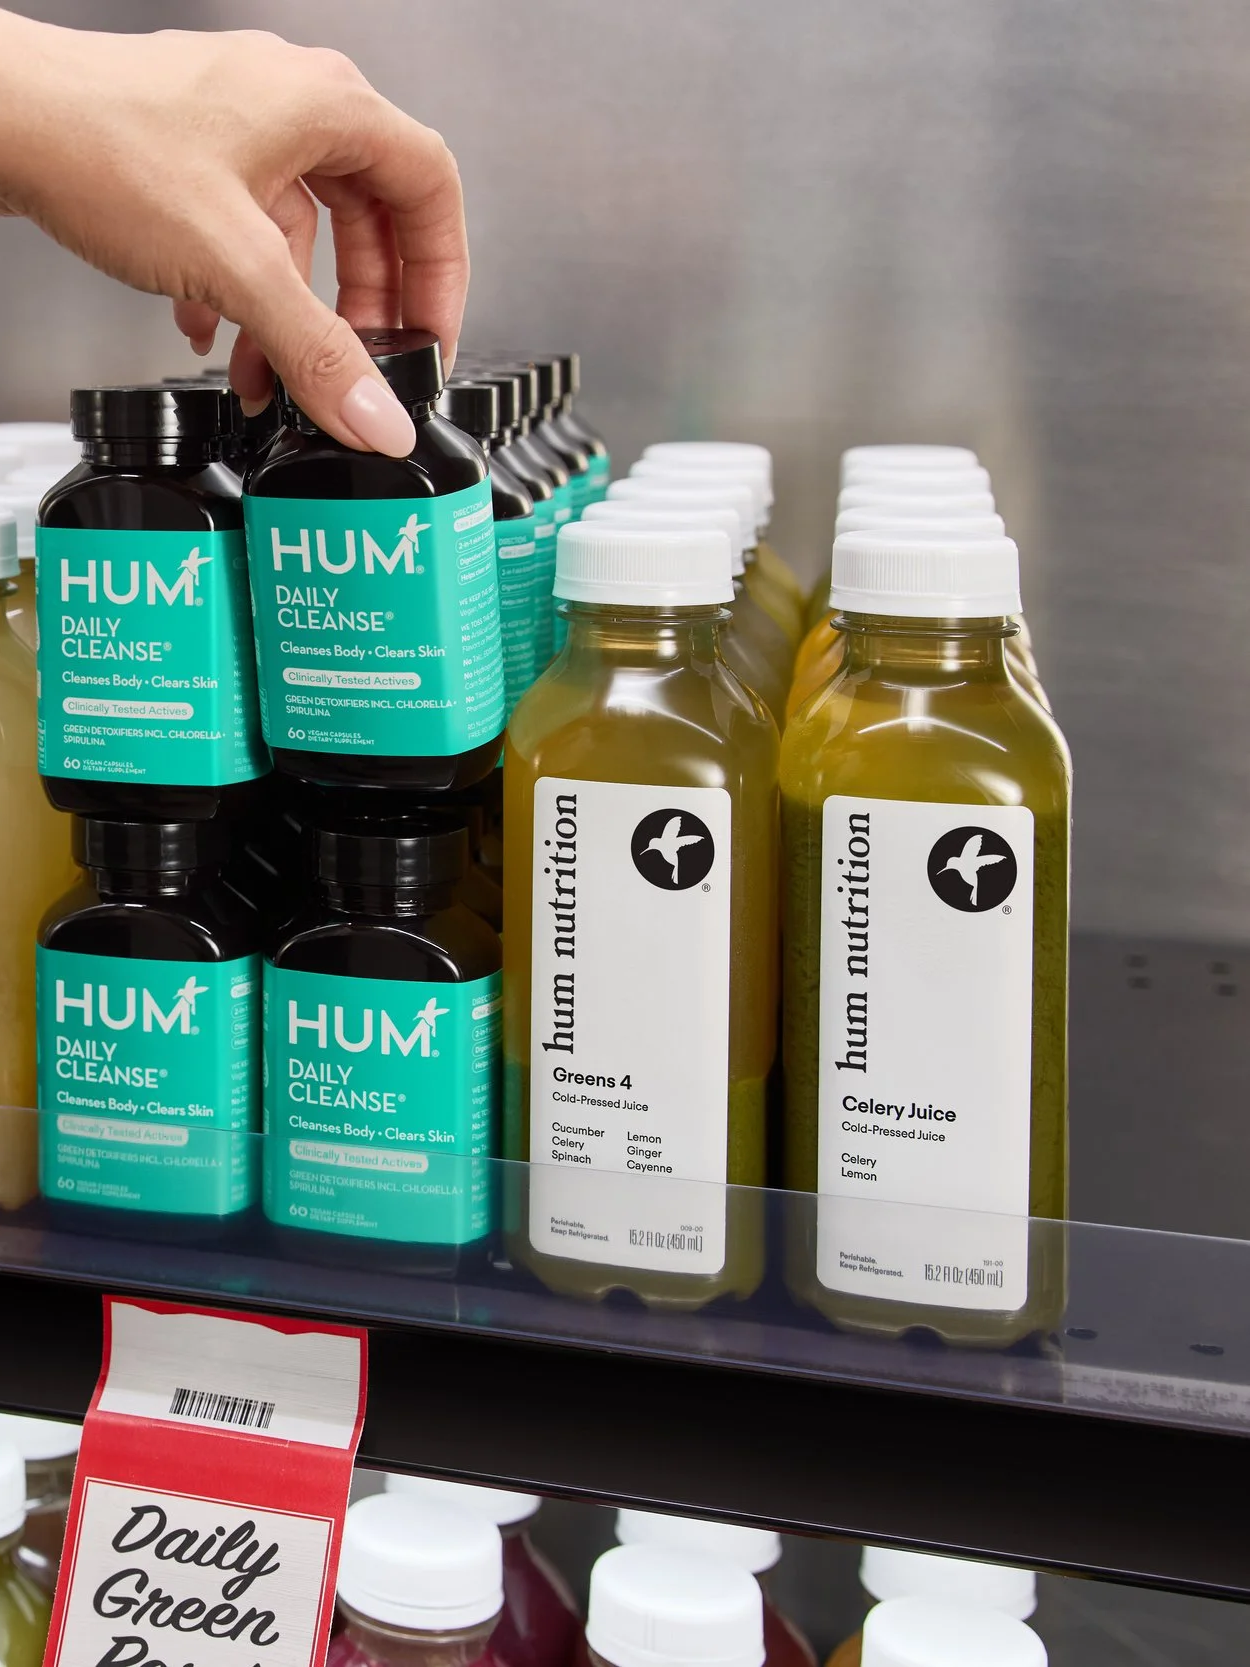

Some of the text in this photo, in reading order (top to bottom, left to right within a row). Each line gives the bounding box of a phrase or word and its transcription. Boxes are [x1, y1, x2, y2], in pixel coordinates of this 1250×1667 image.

[276, 585, 339, 607] DAILY
[62, 616, 121, 637] DAILY
[280, 641, 332, 657] Cleanses
[334, 645, 365, 661] Body
[375, 645, 416, 658] Clears
[62, 671, 111, 686] Cleanses
[113, 674, 142, 690] Body
[152, 675, 190, 689] Clears
[288, 671, 414, 686] Clinically Tested Actives
[68, 701, 187, 716] Clinically Tested Actives
[285, 694, 452, 709] GREEN DETOXIFIERS INCL. CHLORELLA
[286, 706, 330, 717] SPIRULINA
[63, 724, 222, 739] GREEN DETOXIFIERS INCL. CHLORELLA
[287, 726, 305, 740] 60
[308, 729, 361, 739] VEGAN CAPSULES
[63, 735, 105, 746] SPIRULINA
[308, 735, 374, 745] DIETARY SUPPLEMENT
[63, 757, 80, 769] 60
[83, 765, 146, 775] DIETARY SUPPLEMENT
[103, 760, 133, 768] CAPSULES
[542, 793, 577, 1054] hum nutrition
[834, 812, 870, 1073] hum nutrition
[56, 1036, 117, 1062] DAILY
[289, 1058, 353, 1085] DAILY
[553, 1067, 632, 1090] Greens 4
[57, 1091, 214, 1117] Cleanses Body Clears Skin
[552, 1091, 649, 1112] Cold-Pressed Juice
[842, 1095, 956, 1122] Celery Juice
[62, 1121, 182, 1142] Clinically Tested Actives
[289, 1115, 341, 1135] Cleanses
[344, 1123, 375, 1141] Body
[385, 1128, 426, 1143] Clears
[552, 1122, 605, 1138] Cucumber
[842, 1121, 946, 1142] Cold-Pressed Juice
[552, 1136, 584, 1151] Celery
[627, 1131, 661, 1144] Lemon
[295, 1144, 422, 1169] Clinically Tested Actives
[551, 1150, 591, 1165] Spinach
[627, 1145, 662, 1159] Ginger
[627, 1160, 673, 1174] Cayenne
[841, 1153, 877, 1168] Celery
[841, 1167, 877, 1181] Lemon
[57, 1176, 74, 1190] 60
[289, 1170, 318, 1183] GREEN
[402, 1184, 458, 1195] CHLORELLA
[289, 1180, 335, 1197] SPIRULINA
[289, 1204, 308, 1217] 60
[630, 1229, 645, 1246] 15.2
[655, 1232, 665, 1248] Oz
[667, 1232, 685, 1250] (450
[687, 1234, 703, 1253] mL)
[840, 1261, 857, 1272] Keep
[925, 1264, 940, 1282] 15.2
[953, 1267, 963, 1284] Oz
[966, 1267, 985, 1286] (450
[987, 1269, 1003, 1288] mL)
[111, 1504, 281, 1601] Daily
[92, 1567, 280, 1646] Green
